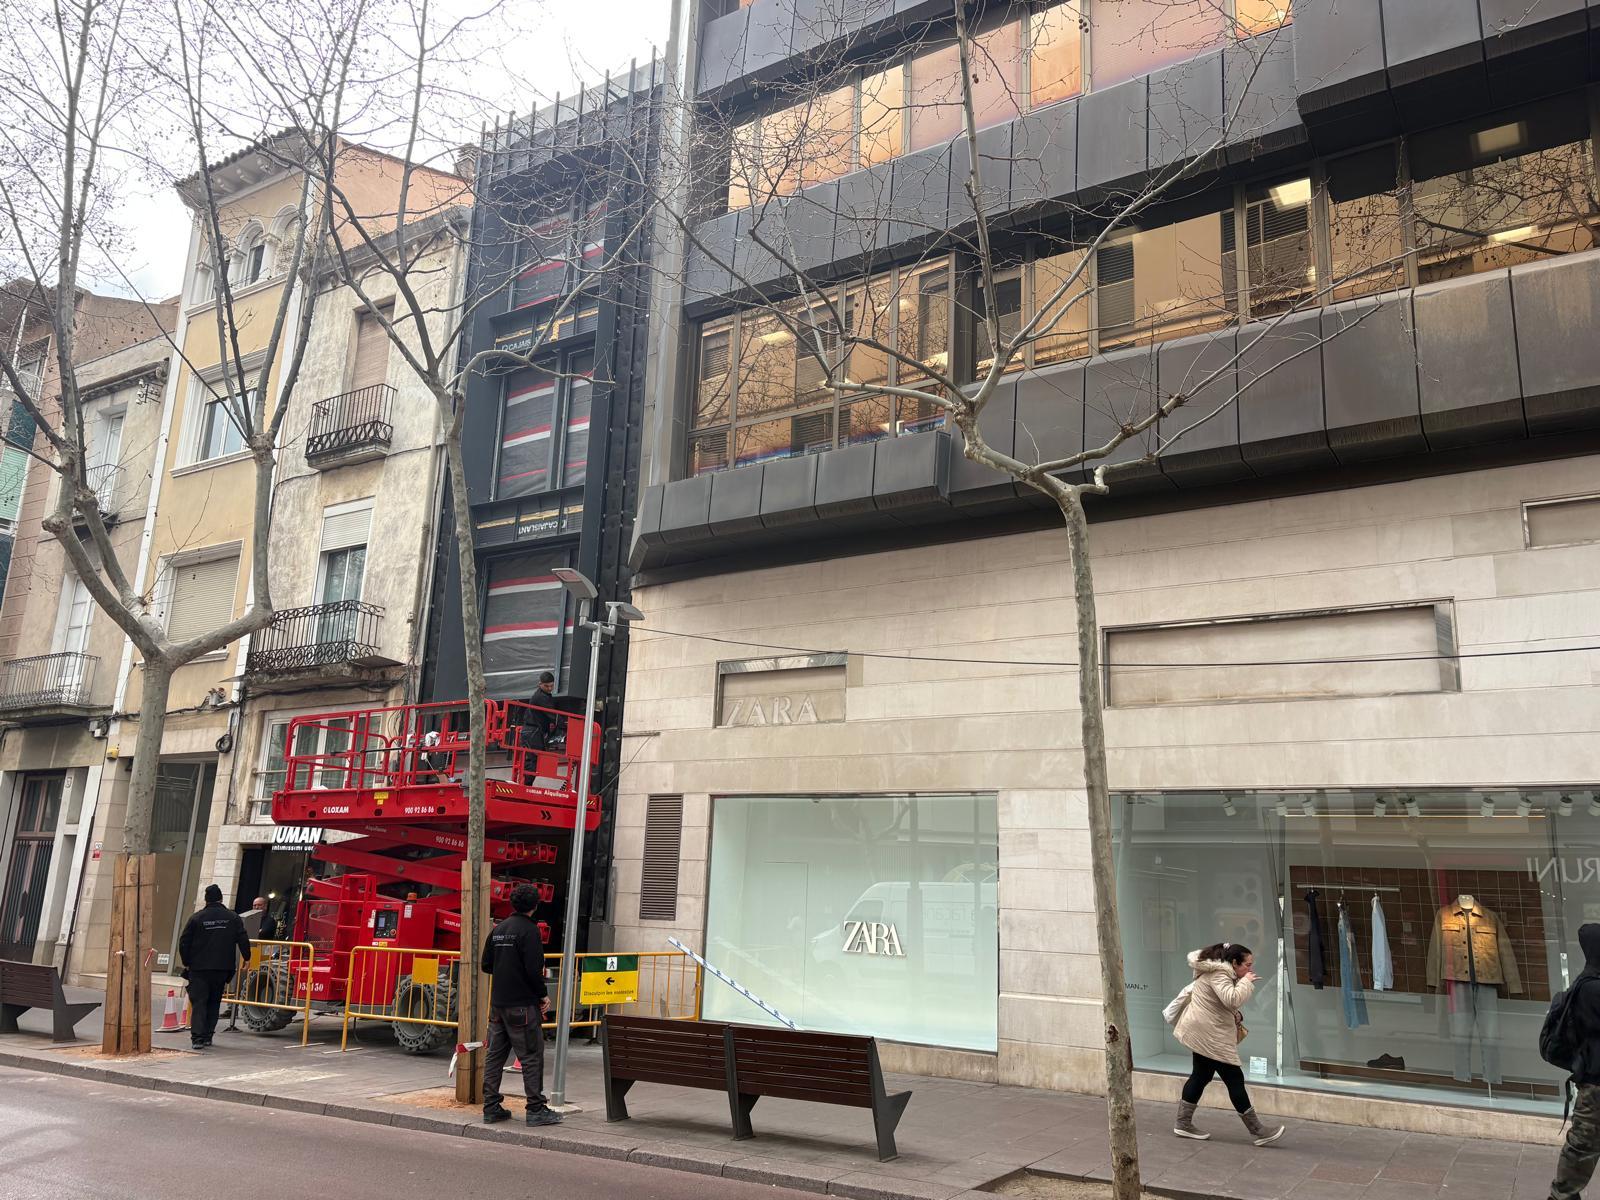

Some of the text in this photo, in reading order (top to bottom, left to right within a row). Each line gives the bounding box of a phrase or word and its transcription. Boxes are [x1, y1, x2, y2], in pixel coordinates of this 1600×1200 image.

[726, 693, 819, 726] ZARA
[327, 806, 349, 814] LOXAM
[404, 806, 414, 814] 900
[414, 806, 421, 814] 92
[842, 919, 907, 957] ZARA
